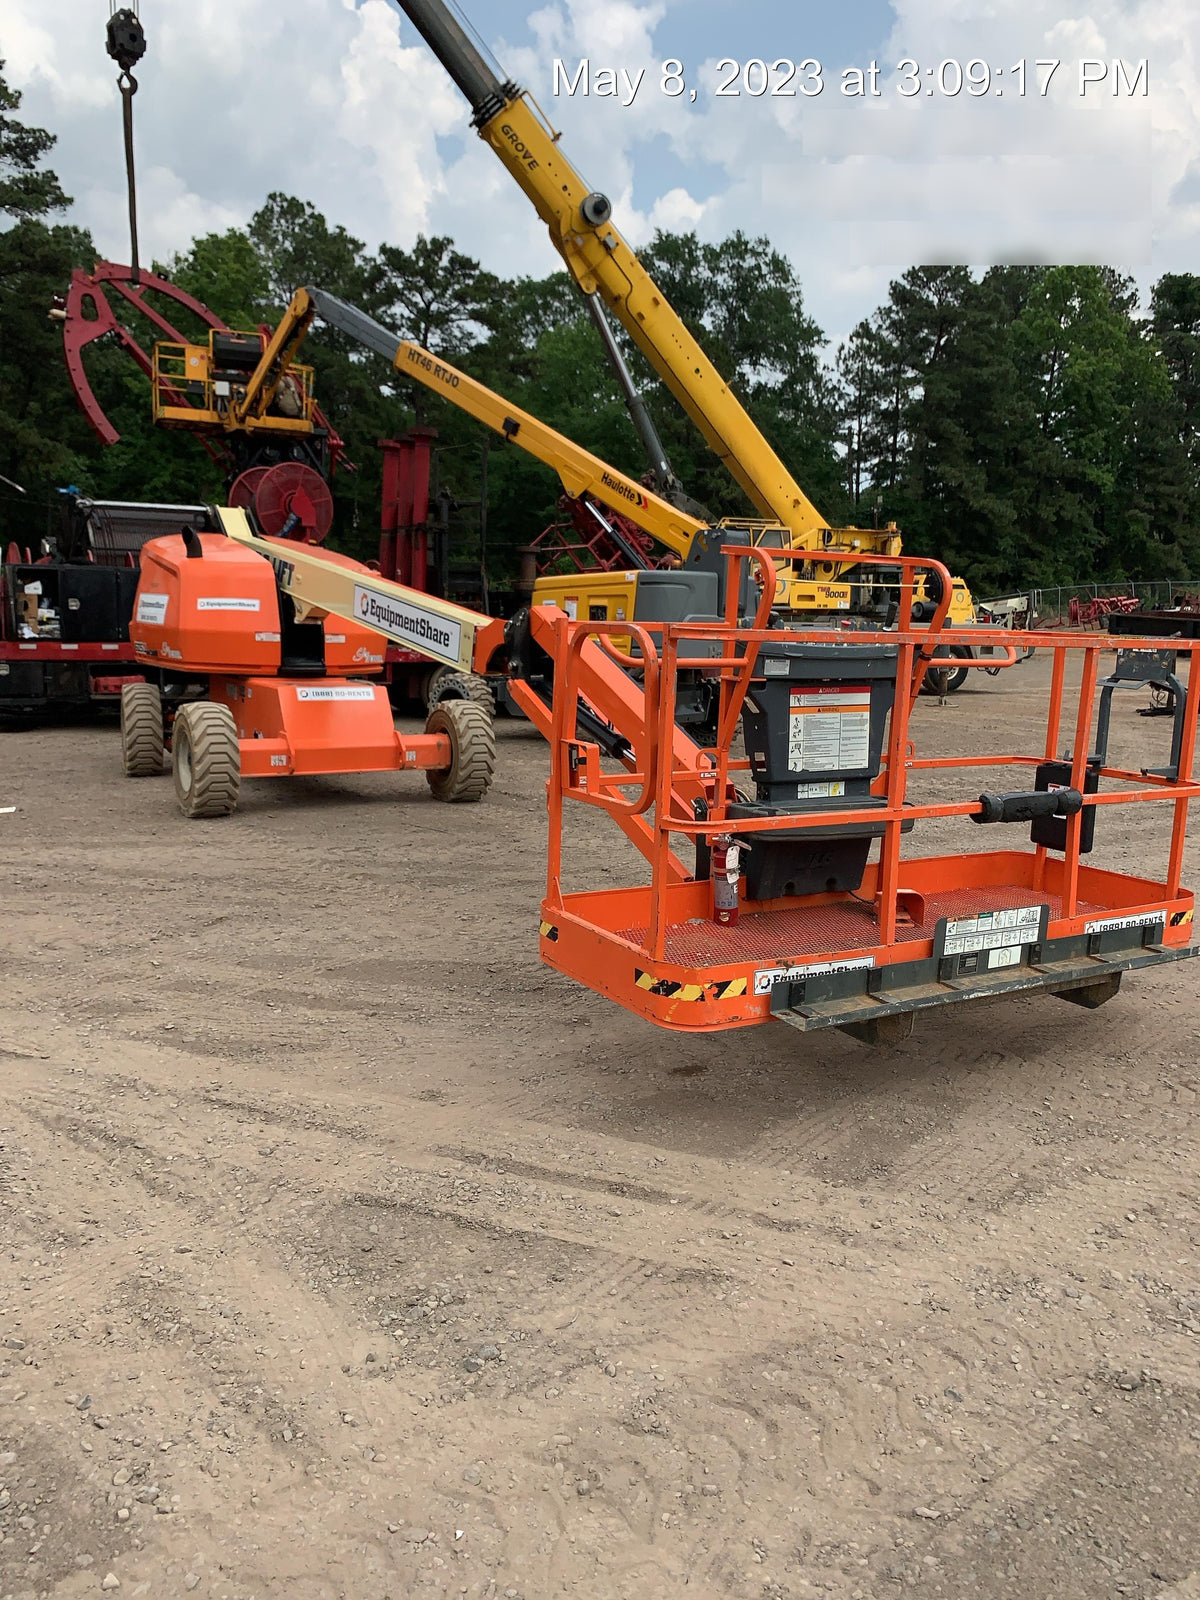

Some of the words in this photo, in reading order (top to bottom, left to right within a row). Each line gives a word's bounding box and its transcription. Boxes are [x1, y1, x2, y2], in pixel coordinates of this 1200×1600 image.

[501, 124, 540, 171] GROVE
[408, 348, 433, 372] HT46
[601, 471, 636, 502] Haulotte
[369, 598, 450, 648] EquipmentShare
